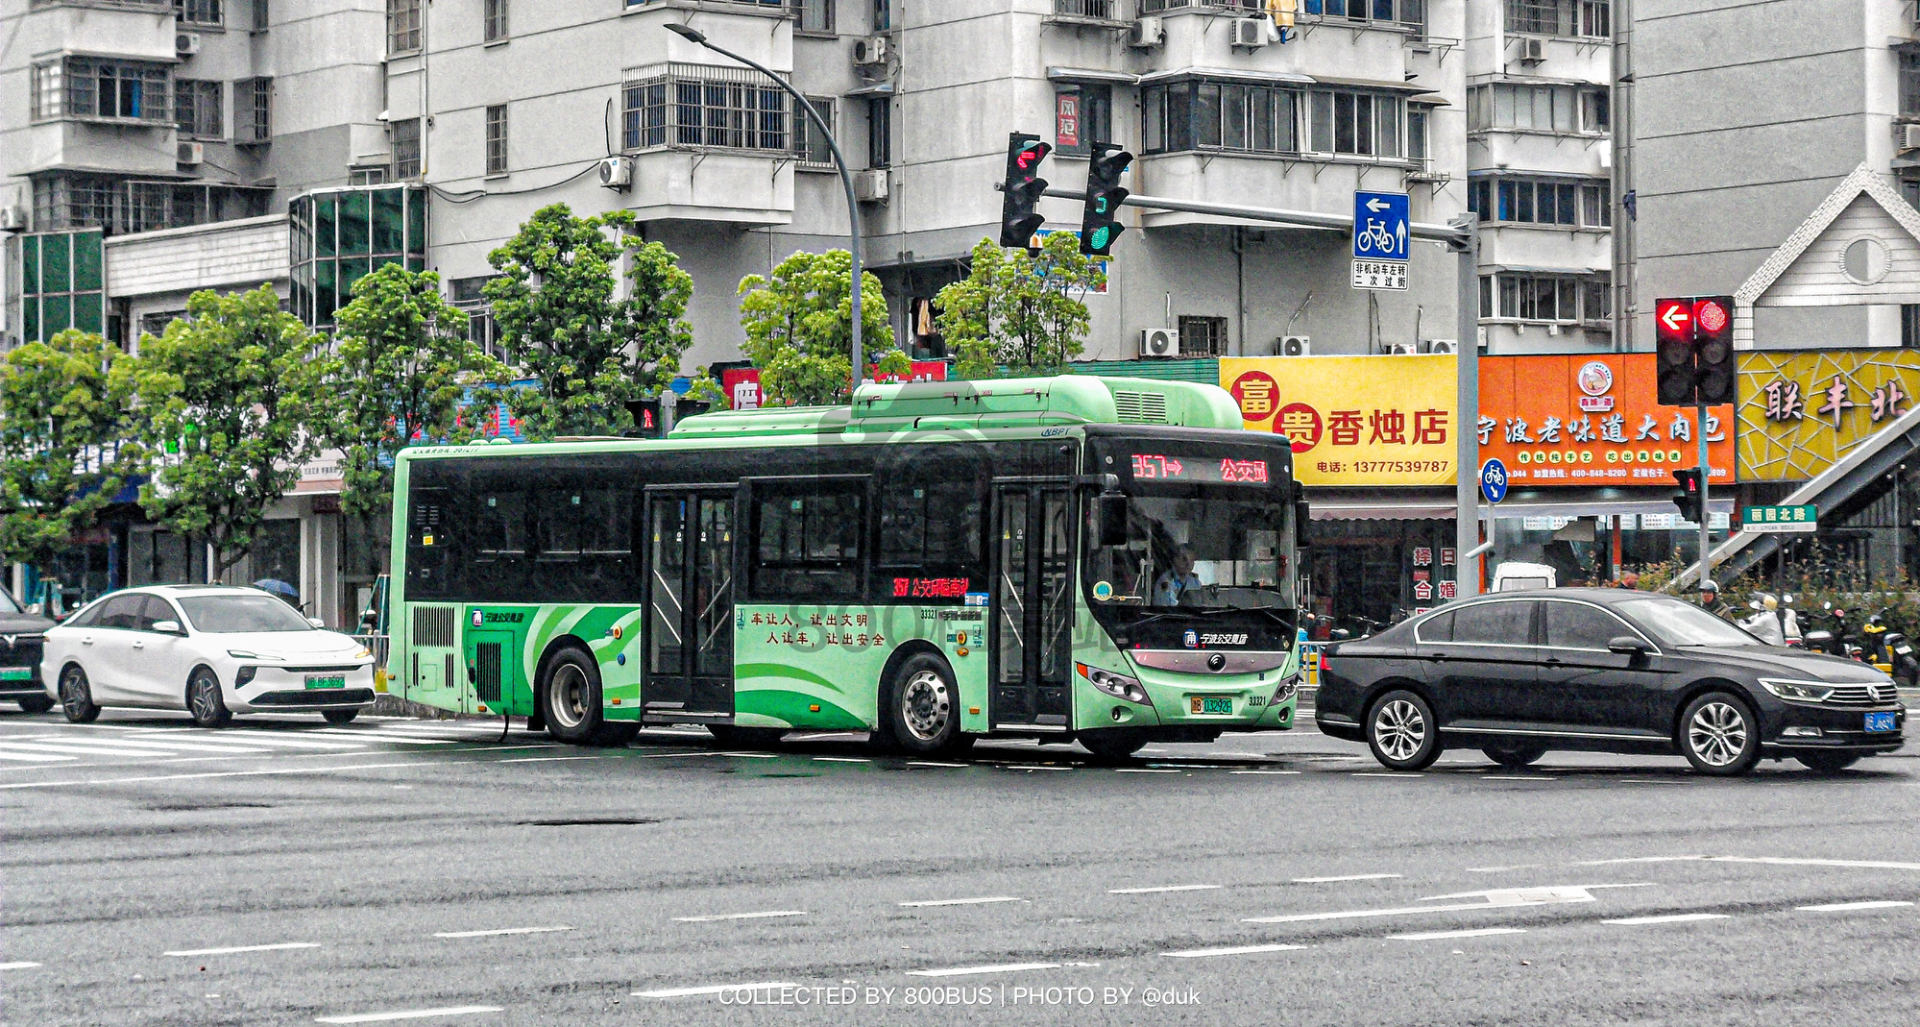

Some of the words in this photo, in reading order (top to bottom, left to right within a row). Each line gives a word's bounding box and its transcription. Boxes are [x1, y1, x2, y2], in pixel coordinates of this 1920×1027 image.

[1355, 262, 1406, 277] 非机动车左转
[1354, 275, 1406, 288] 二次过街
[1131, 454, 1168, 478] 357
[1751, 507, 1806, 521] 丽园北路
[920, 609, 938, 620] 33321
[1248, 696, 1266, 706] 33321
